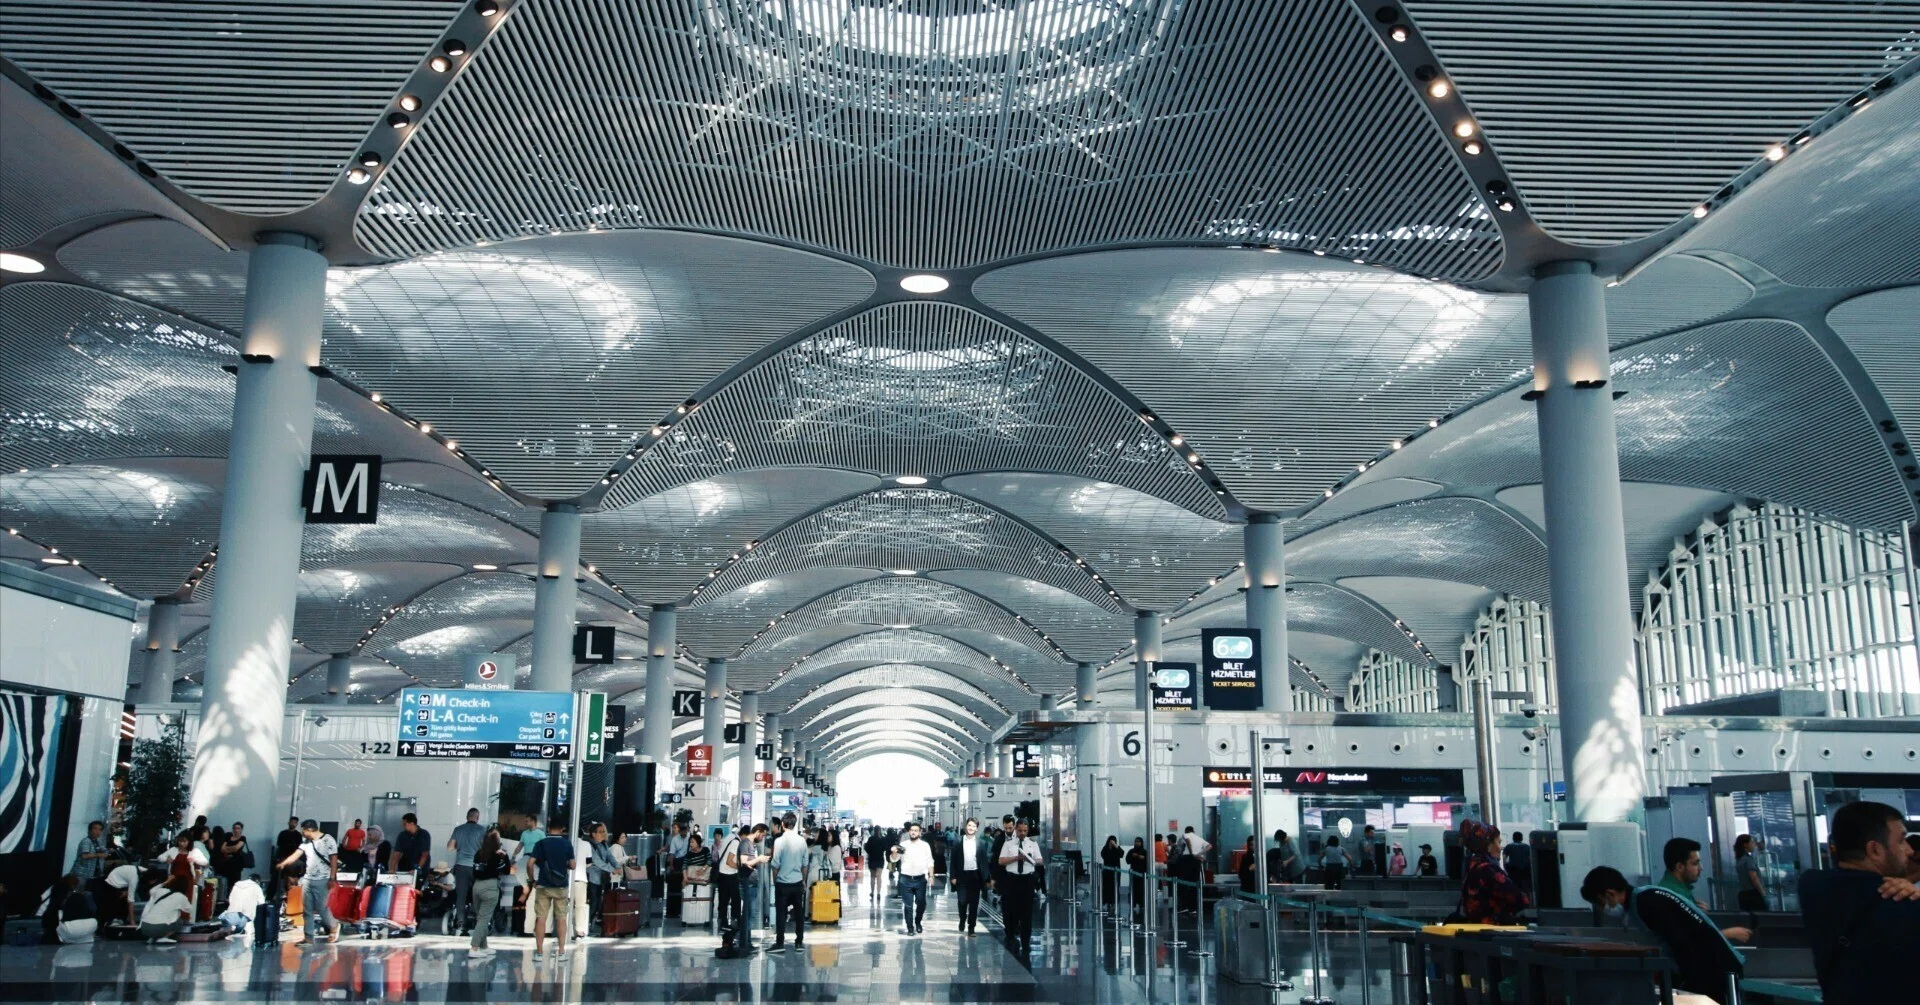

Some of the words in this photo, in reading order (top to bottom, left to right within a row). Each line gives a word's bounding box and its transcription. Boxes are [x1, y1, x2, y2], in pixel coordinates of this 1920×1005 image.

[312, 463, 368, 513] M
[586, 631, 603, 659] L
[1216, 639, 1229, 656] 6
[1222, 661, 1244, 670] BİLET
[1159, 671, 1170, 686] 6
[1210, 669, 1256, 679] HİZMETLERİ
[1164, 690, 1182, 698] BİLET
[432, 694, 446, 707] M
[449, 697, 490, 708] Check-in
[680, 693, 695, 714] K
[1154, 696, 1192, 705] HİZMETLERİ
[431, 709, 455, 722] L-A
[457, 713, 499, 724] Check-in
[731, 725, 740, 742] J
[360, 742, 391, 754] 1-22
[1122, 730, 1141, 756] 6
[759, 745, 771, 759] H
[780, 758, 790, 770] G
[796, 767, 803, 776] F
[1245, 772, 1283, 780] TVEL
[807, 774, 813, 783] E
[815, 780, 821, 788] D
[684, 783, 696, 797] K
[987, 786, 995, 798] 5
[950, 801, 955, 809] 4
